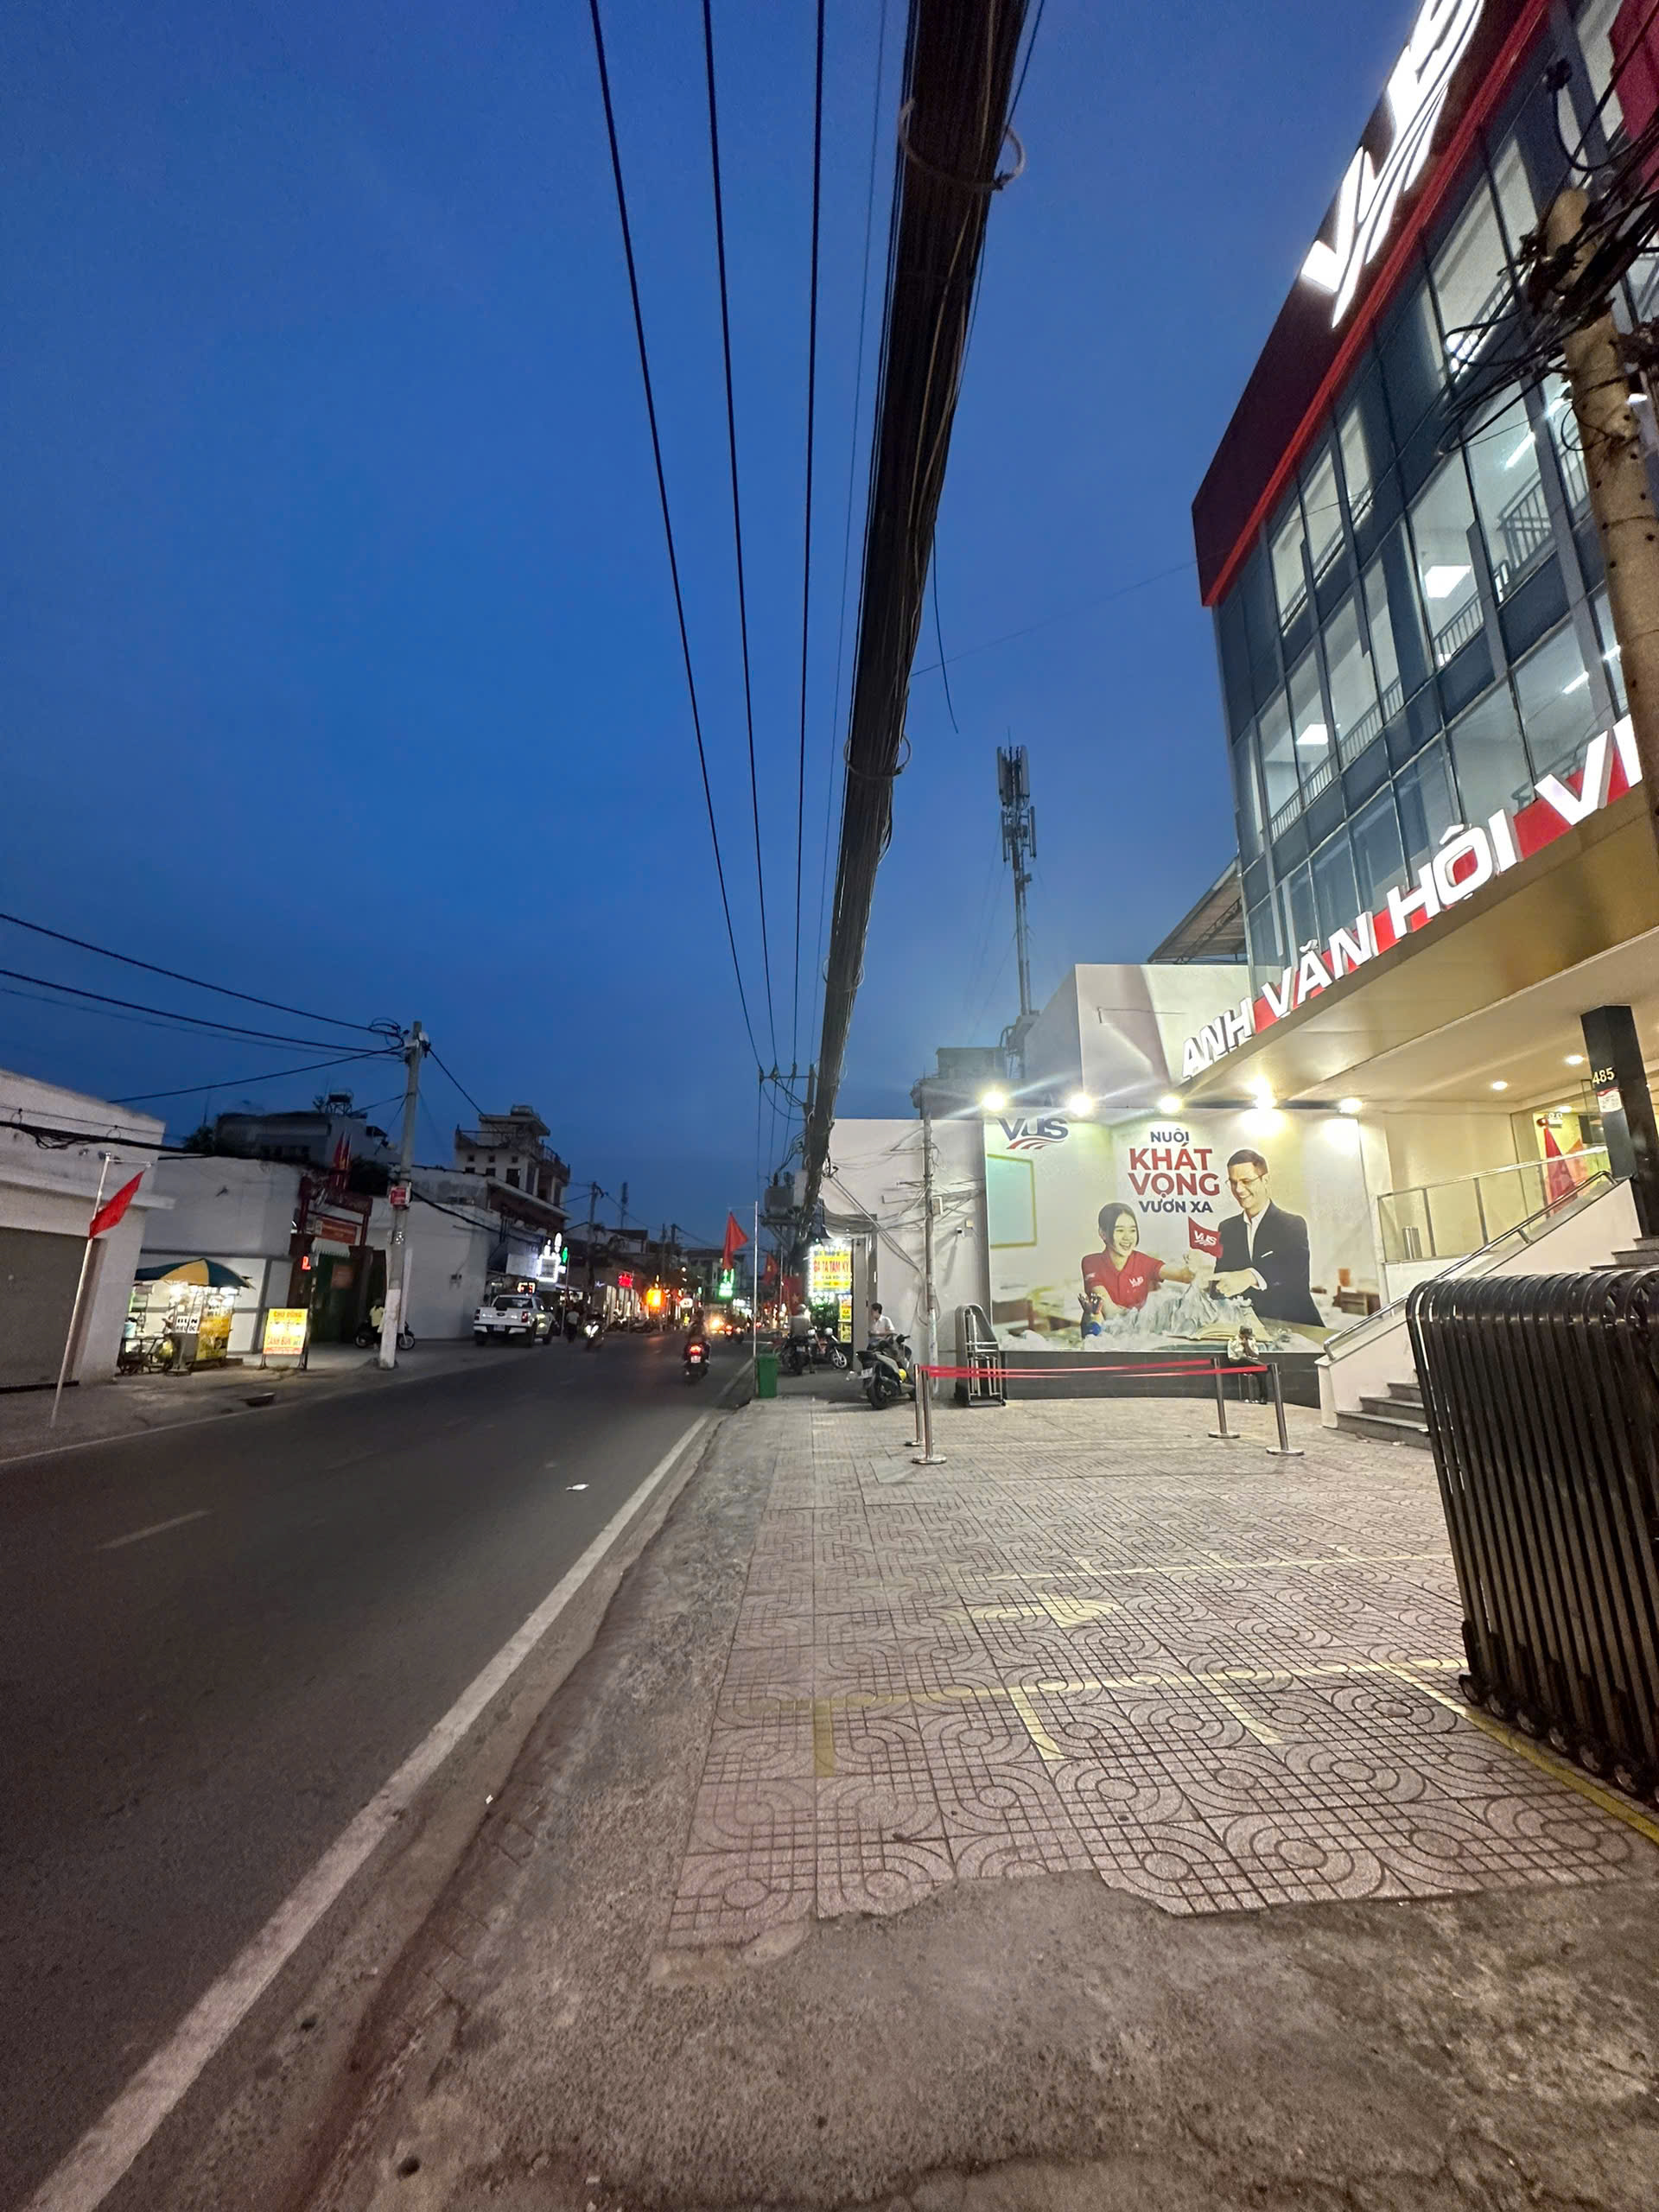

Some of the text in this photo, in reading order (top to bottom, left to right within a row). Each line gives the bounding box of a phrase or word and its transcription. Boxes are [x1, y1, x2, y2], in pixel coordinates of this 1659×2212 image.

[1182, 996, 1255, 1080] ANH
[1261, 911, 1377, 1018] VĂN
[1386, 809, 1518, 939] HỘI
[1592, 1067, 1614, 1084] 485
[997, 1117, 1069, 1141] VUS
[1150, 1128, 1190, 1142] NUÔI
[1129, 1142, 1212, 1170] KHÁT
[1128, 1173, 1220, 1198] VỌNG
[1139, 1200, 1213, 1213] VƯƠN XA
[1194, 1230, 1217, 1245] VUS
